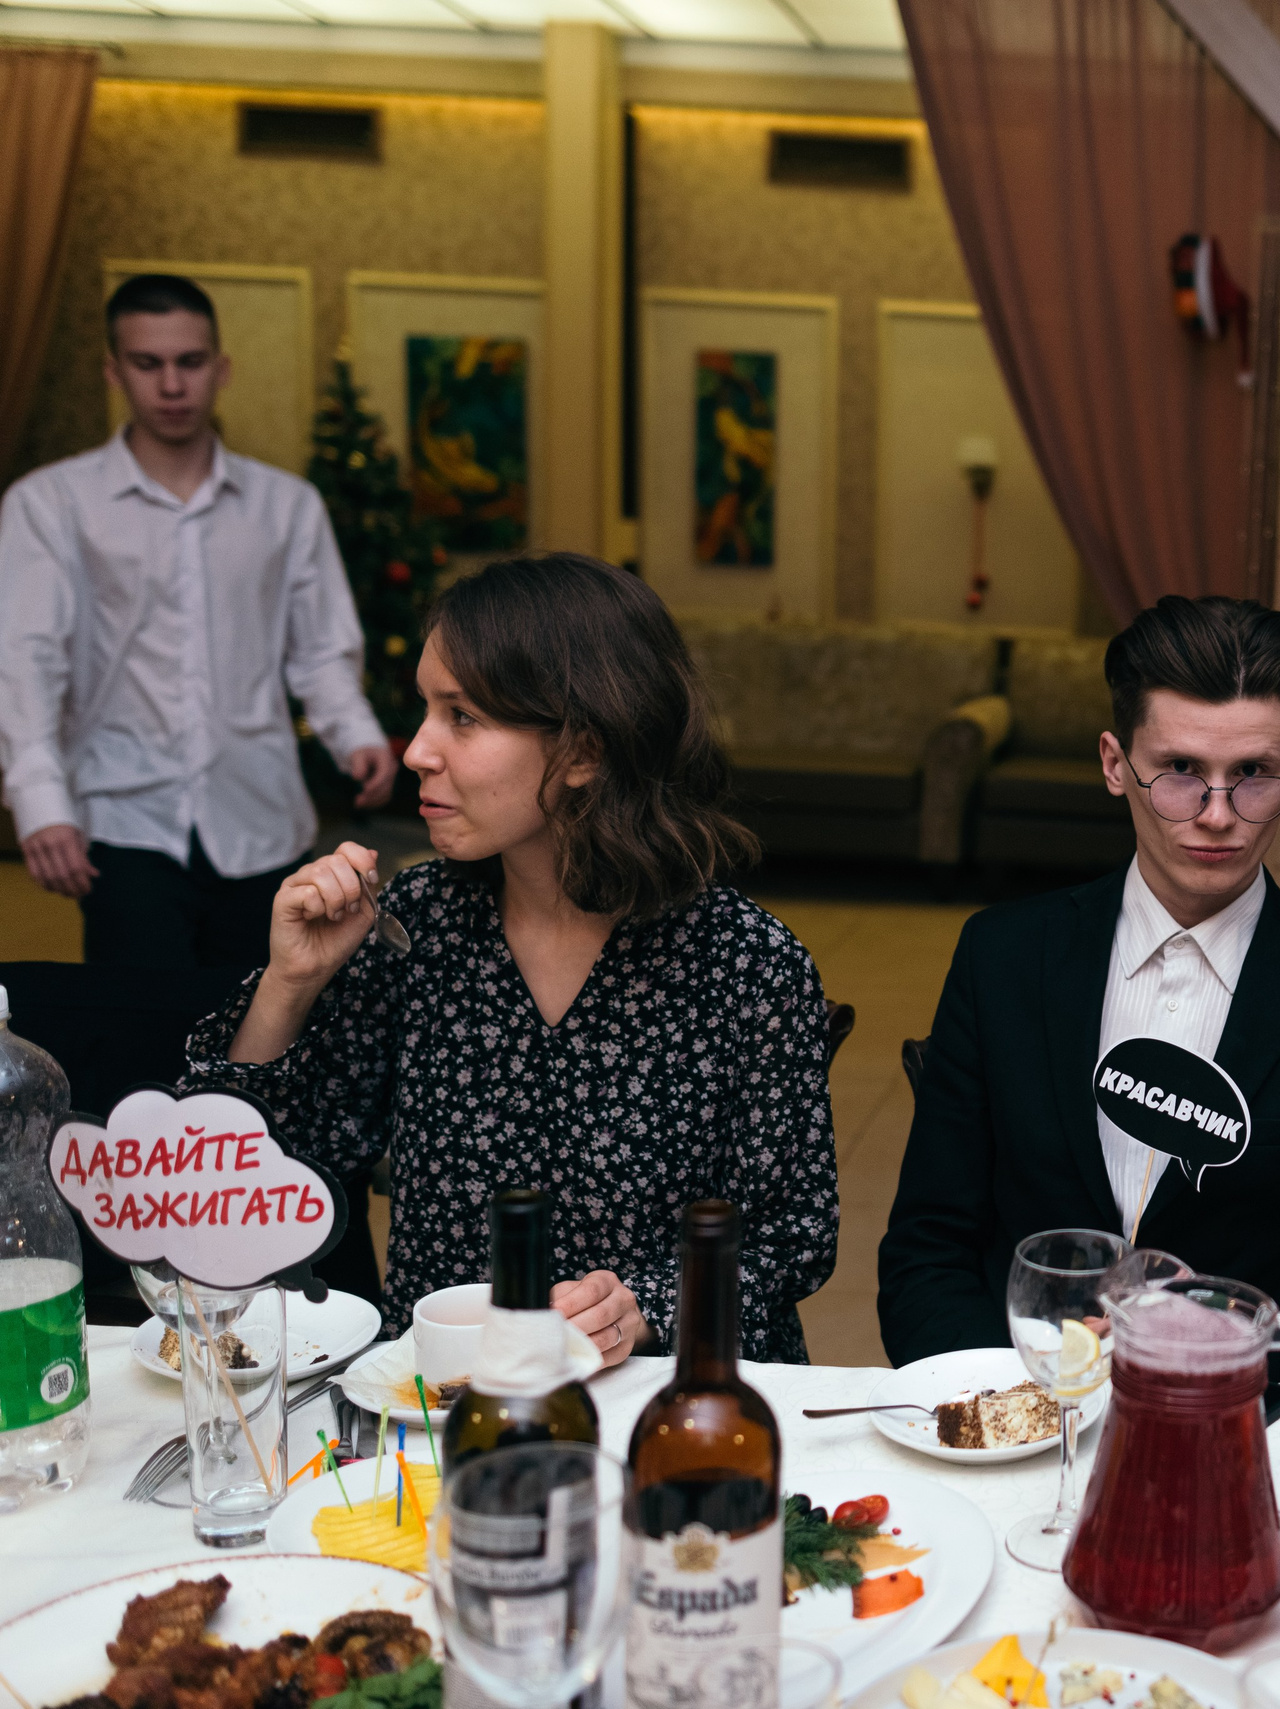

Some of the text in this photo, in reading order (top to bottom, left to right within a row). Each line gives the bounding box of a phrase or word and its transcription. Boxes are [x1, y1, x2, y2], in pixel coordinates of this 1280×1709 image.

[1098, 1066, 1245, 1144] КРАСАВЧИК
[60, 1125, 265, 1186] ДАВАЙТЕ
[93, 1184, 325, 1230] ЗАЖИГАТЬ
[634, 1569, 758, 1622] Espada
